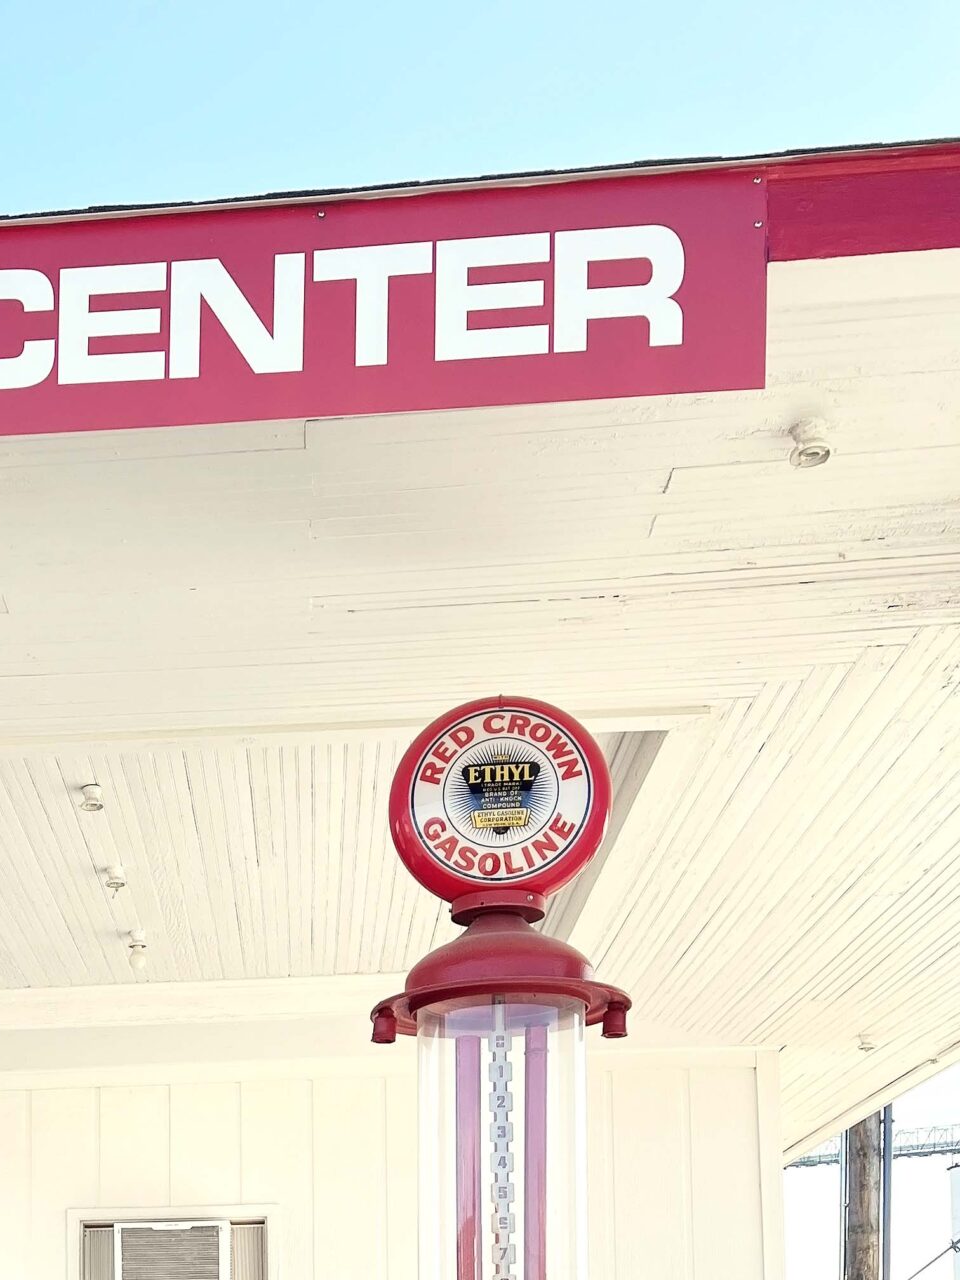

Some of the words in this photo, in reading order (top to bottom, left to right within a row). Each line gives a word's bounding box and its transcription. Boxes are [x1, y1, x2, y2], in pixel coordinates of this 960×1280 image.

[420, 726, 474, 785] RED
[483, 714, 583, 781] CROWN
[468, 763, 535, 784] ETHYL
[423, 812, 576, 877] GASOLINE
[498, 1065, 504, 1078] 1
[497, 1096, 506, 1108] 2
[497, 1126, 506, 1138] 3
[497, 1156, 507, 1168] 4
[499, 1248, 507, 1260] 7
